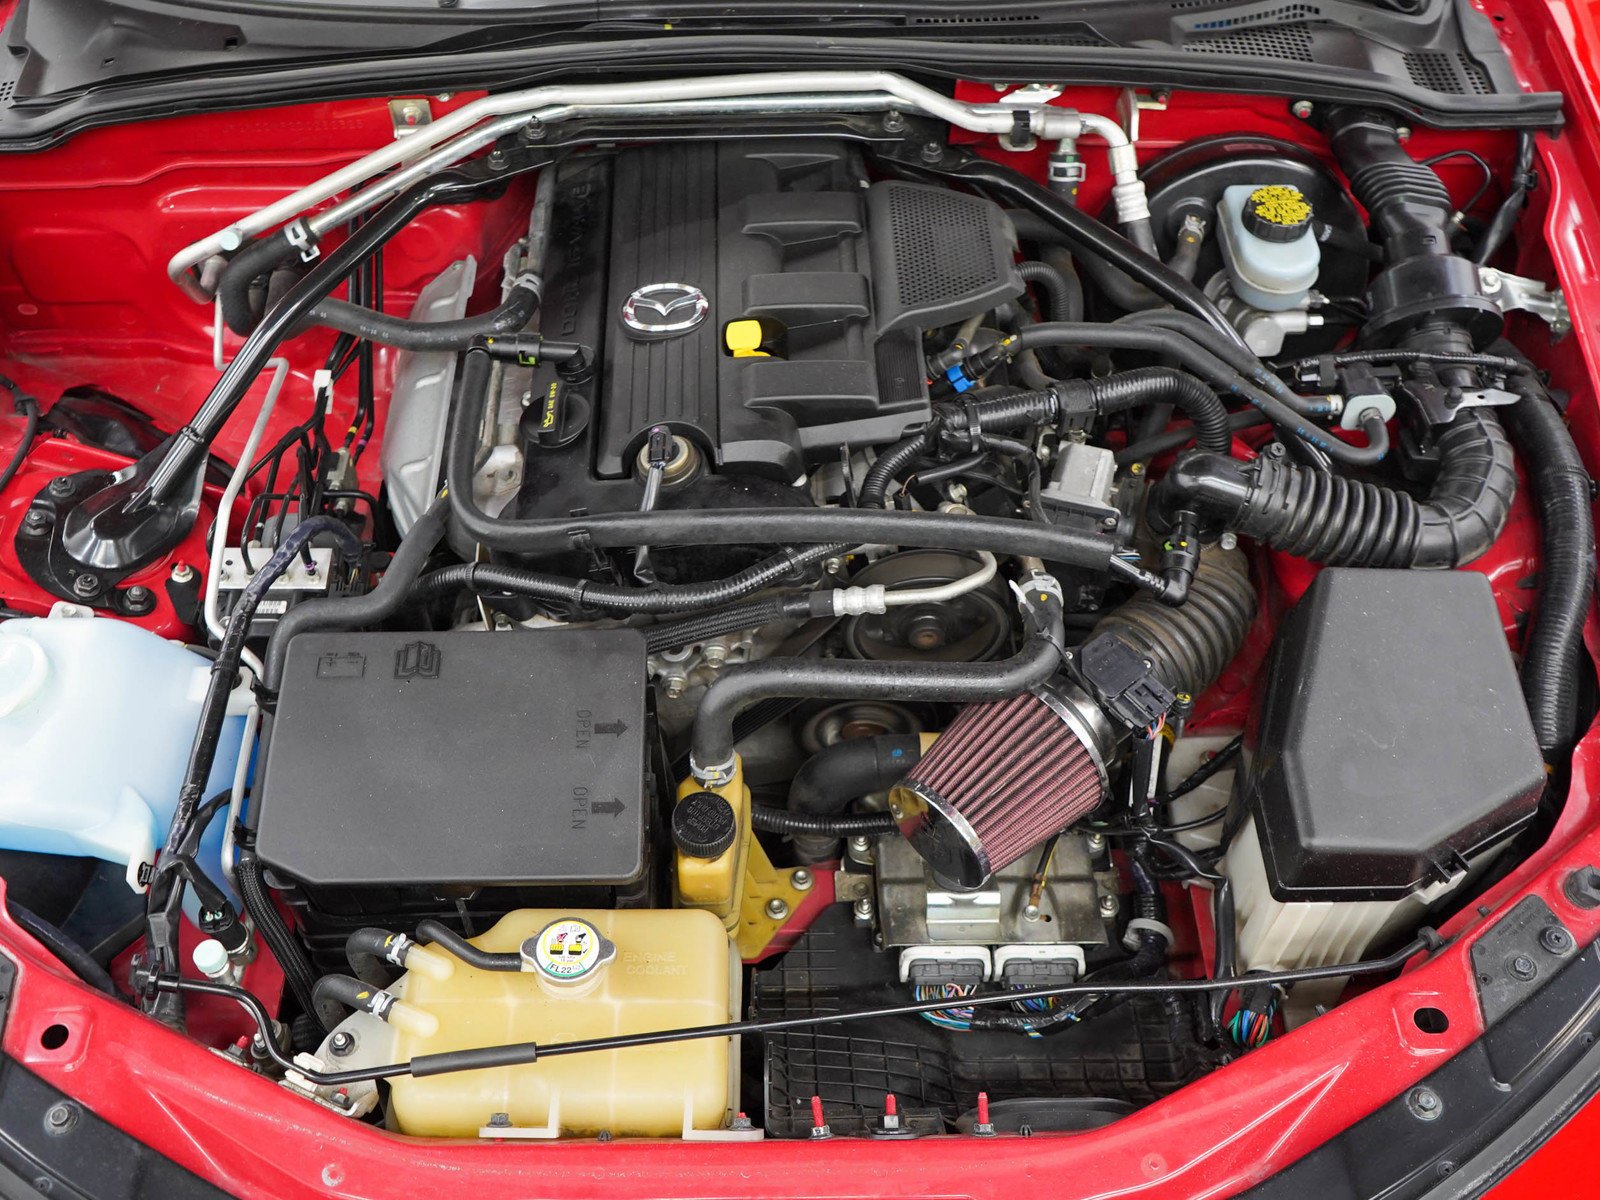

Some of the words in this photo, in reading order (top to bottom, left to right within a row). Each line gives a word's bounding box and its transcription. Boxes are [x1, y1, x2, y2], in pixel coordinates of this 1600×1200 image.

[576, 709, 593, 749] OPEN
[571, 786, 588, 829] OPEN
[623, 951, 677, 962] ENGINE
[549, 963, 572, 974] FL22
[626, 964, 689, 976] COOLANT
